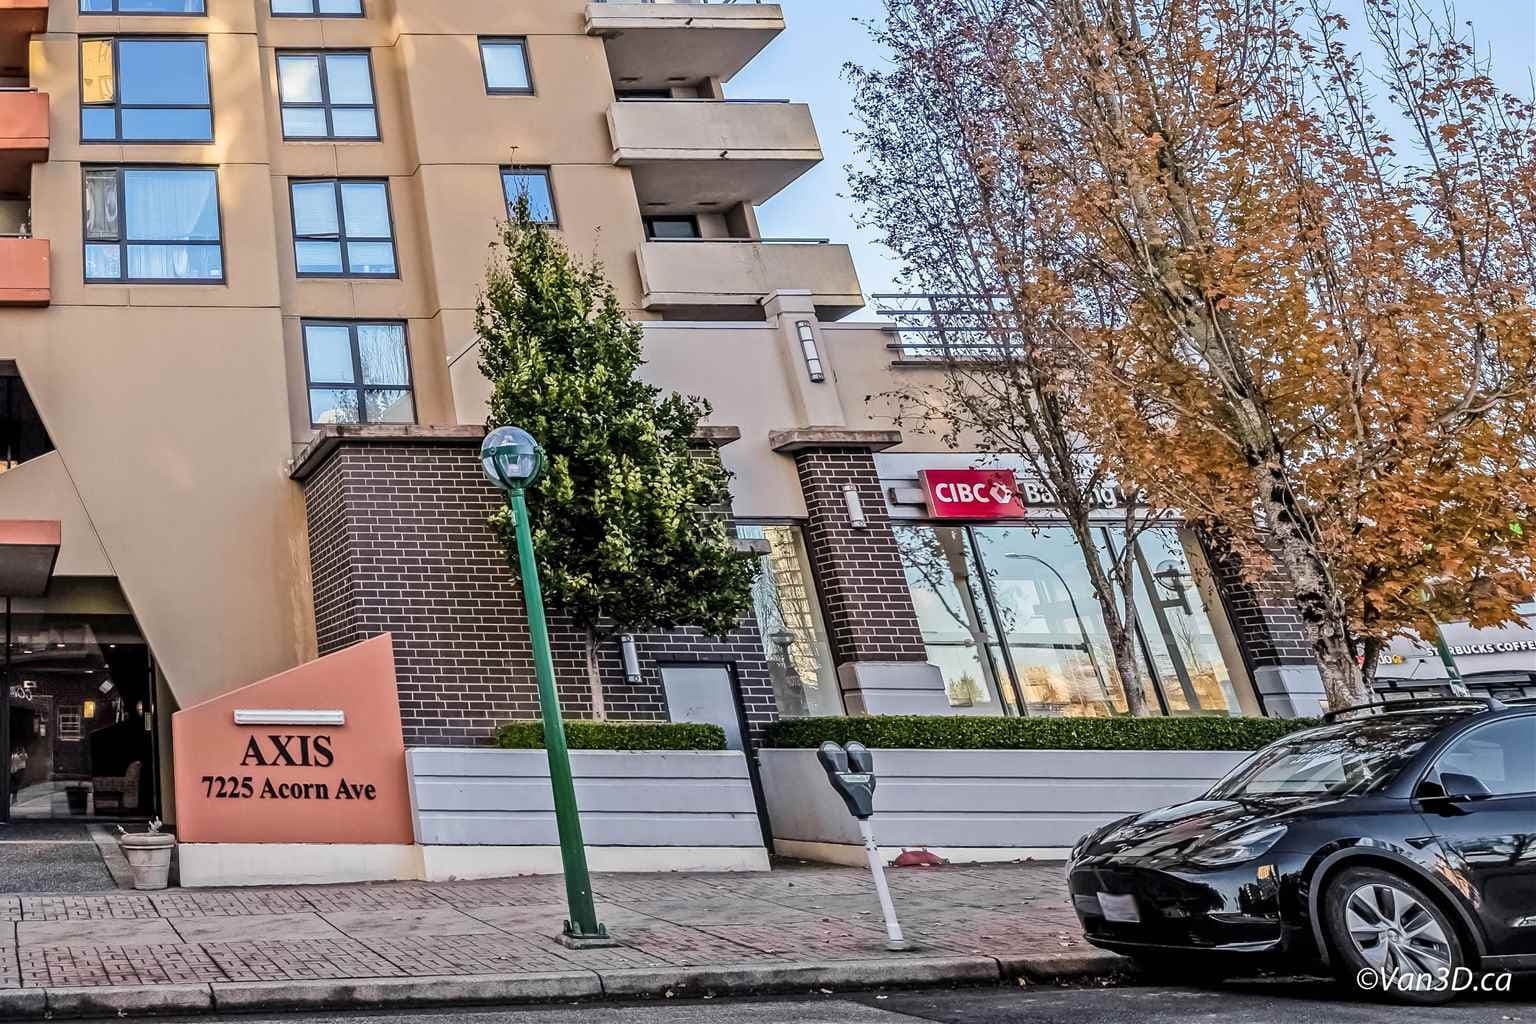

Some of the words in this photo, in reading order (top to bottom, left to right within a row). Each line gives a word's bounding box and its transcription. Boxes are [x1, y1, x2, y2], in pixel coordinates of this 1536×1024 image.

[935, 482, 990, 503] CIBC
[1427, 643, 1495, 657] STRBUCKS
[1496, 640, 1536, 653] COFFE
[240, 735, 334, 767] AXIS
[201, 776, 254, 798] 7225
[259, 778, 329, 799] Acorn
[335, 778, 377, 800] Ave
